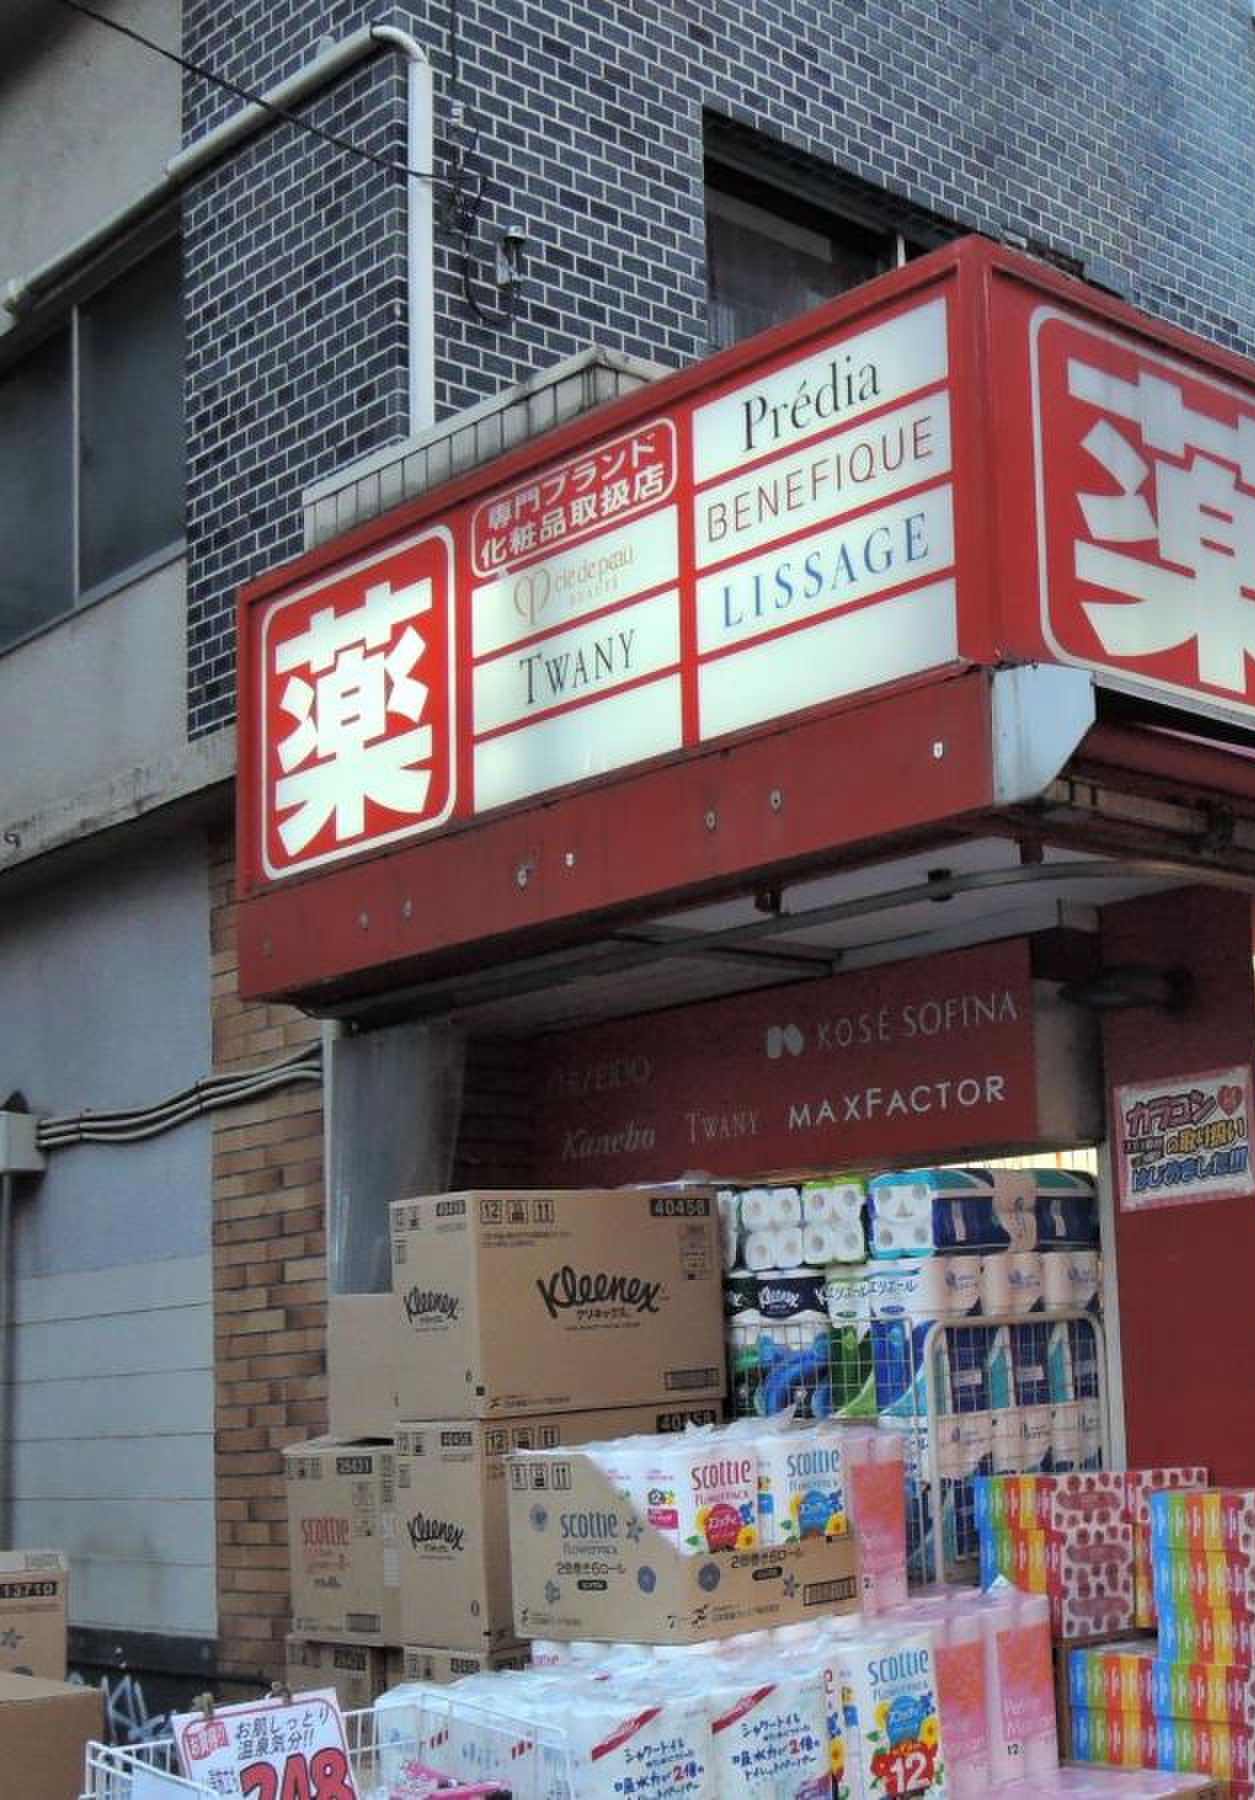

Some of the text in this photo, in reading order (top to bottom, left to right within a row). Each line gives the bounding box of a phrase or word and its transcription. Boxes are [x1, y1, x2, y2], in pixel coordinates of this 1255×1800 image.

[742, 356, 881, 454] Prédia
[486, 432, 656, 530] 専門ブランド
[707, 416, 934, 544] BENEFIQUE
[480, 462, 664, 568] 化粧品取扱店
[722, 512, 931, 630] LISSAGE
[273, 576, 433, 858] 薬
[901, 990, 1018, 1038] SOFINA
[788, 1075, 1006, 1130] MAXFACTOR
[403, 1286, 460, 1323] Kleenex
[537, 1265, 662, 1319] Kleenex
[407, 1512, 464, 1552] Kleenex
[560, 1511, 619, 1539] scottie
[868, 1650, 928, 1686] scottie
[238, 1706, 330, 1740] お肌しっとり
[238, 1728, 316, 1760] 温泉気分!!
[240, 1747, 359, 1800] 248
[891, 1752, 932, 1794] 12
